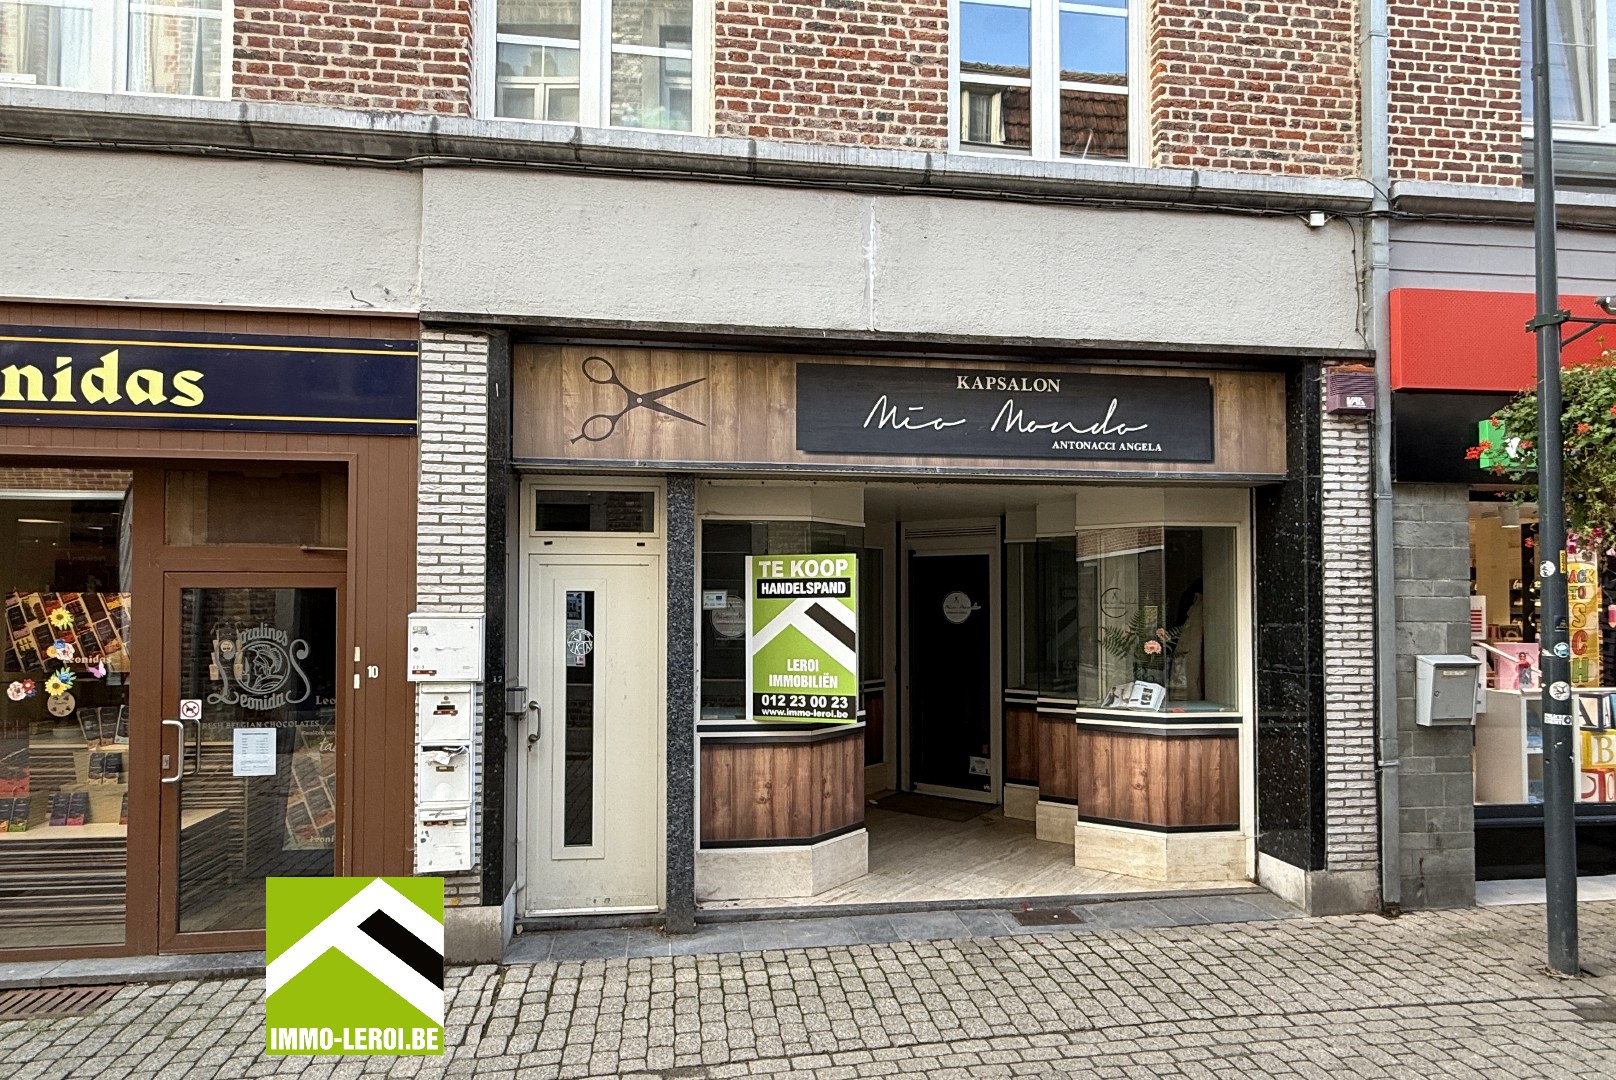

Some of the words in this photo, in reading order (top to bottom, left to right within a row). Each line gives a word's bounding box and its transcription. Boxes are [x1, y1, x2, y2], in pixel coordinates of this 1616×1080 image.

[1, 349, 205, 408] nidas
[956, 375, 1061, 393] KAPSALON
[864, 394, 967, 431] Mio
[990, 398, 1149, 435] Mondo
[1051, 440, 1116, 452] ANTONACCI
[1118, 442, 1163, 452] ANGELA
[758, 560, 784, 578] TE
[790, 559, 849, 578] KOOP
[1567, 569, 1596, 584] ACK
[761, 581, 846, 595] HANDELSPAND
[367, 665, 379, 679] 10
[786, 658, 819, 672] LEROI
[768, 672, 839, 689] IMMOBILIËN
[761, 694, 786, 708] 012
[789, 695, 807, 708] 23
[810, 695, 828, 709] 00
[831, 696, 849, 709] 23
[761, 708, 849, 719] www.immo-leroi.be
[263, 719, 320, 729] CHOCOLATES
[1595, 735, 1614, 764] B
